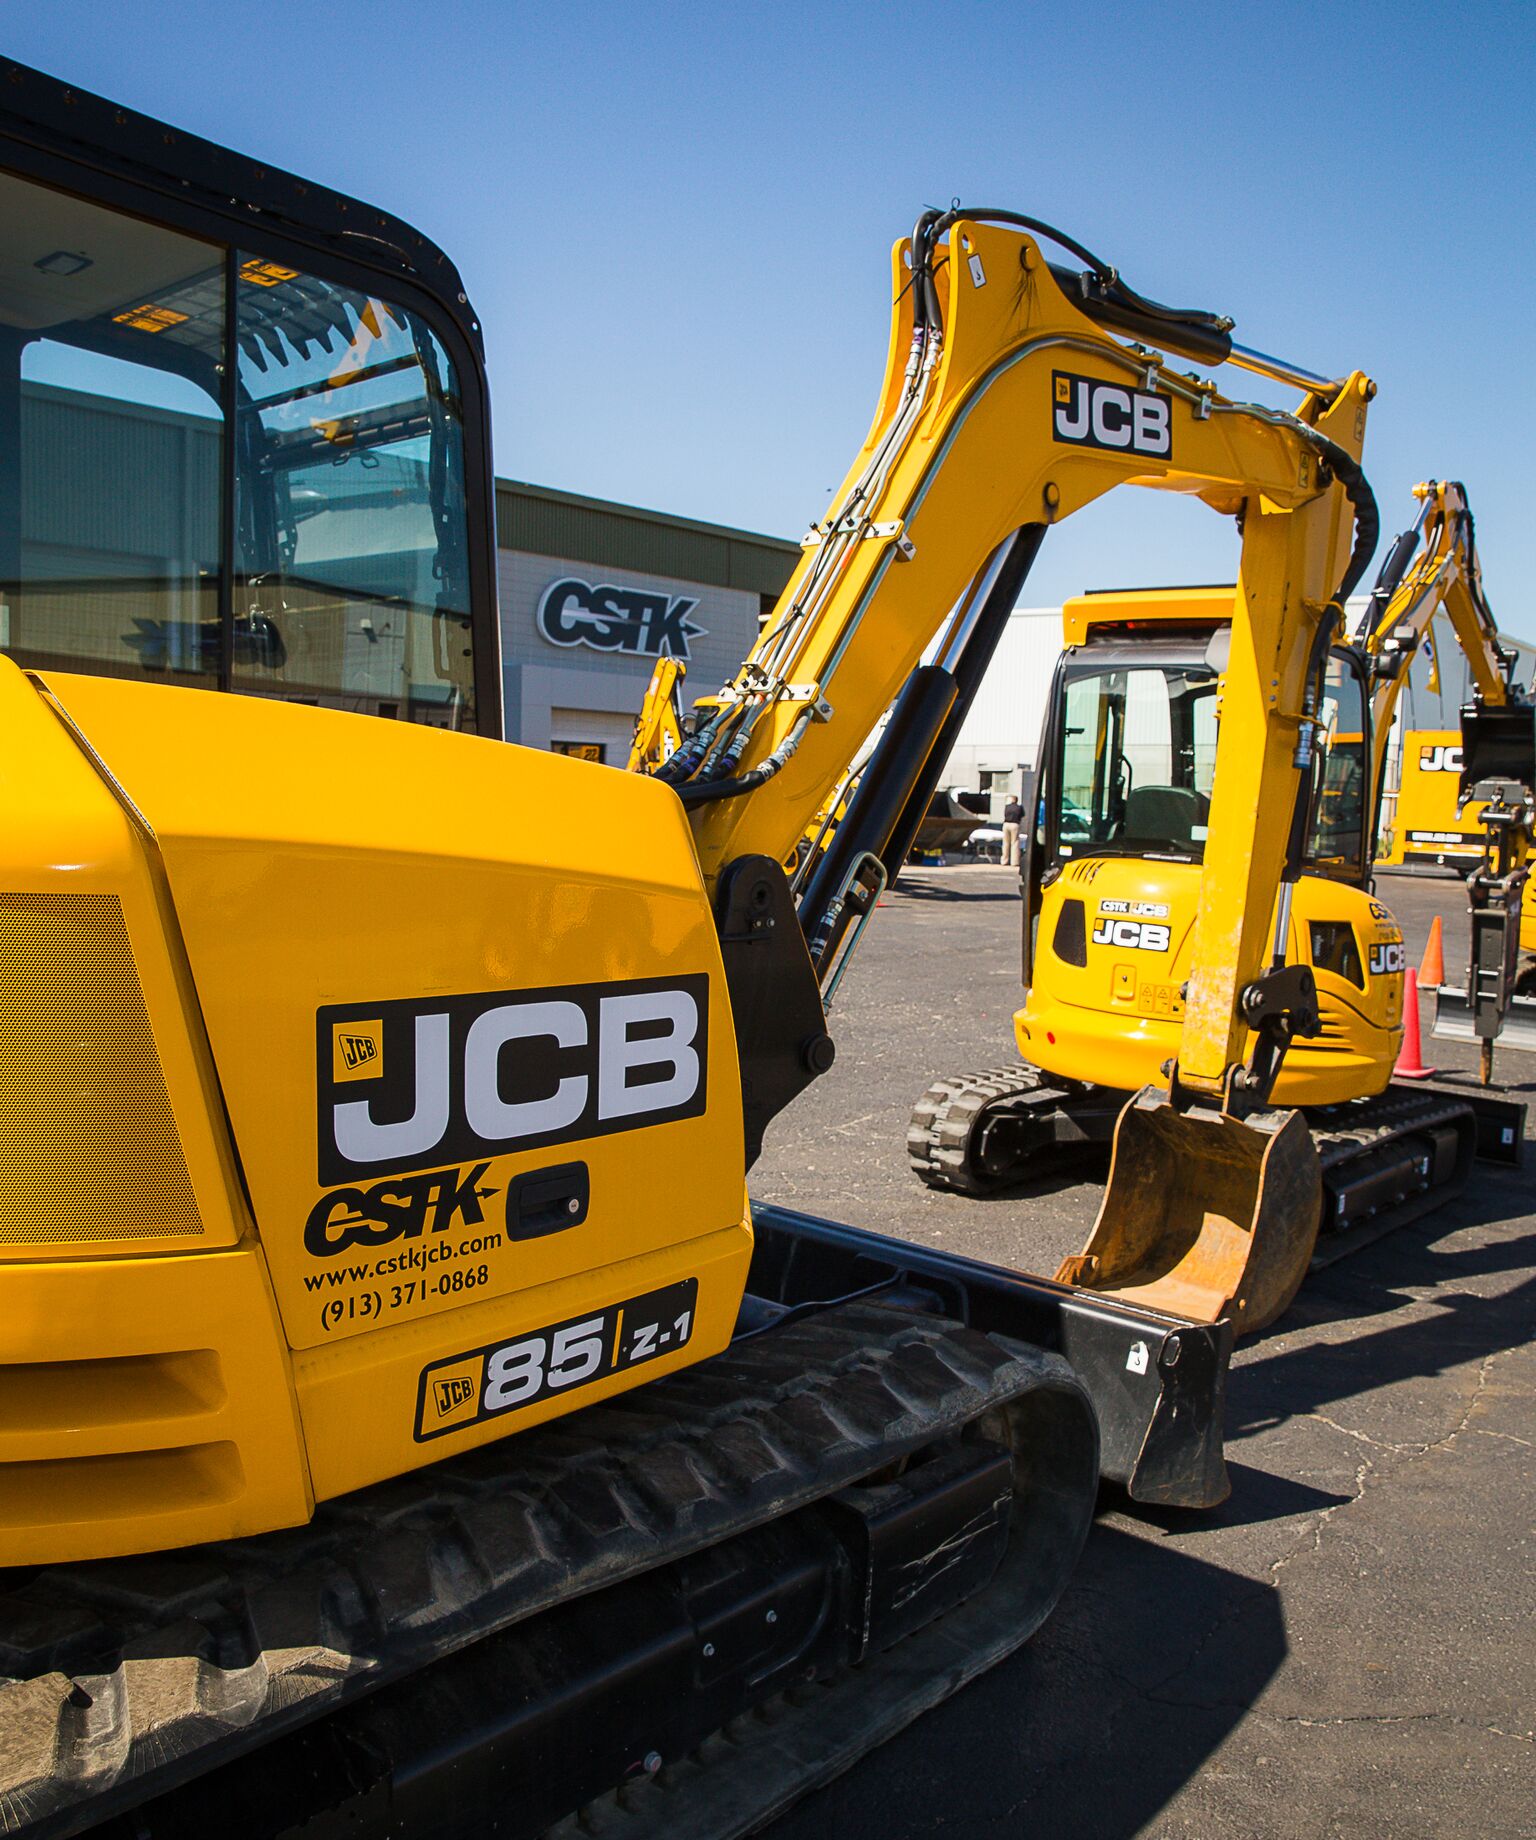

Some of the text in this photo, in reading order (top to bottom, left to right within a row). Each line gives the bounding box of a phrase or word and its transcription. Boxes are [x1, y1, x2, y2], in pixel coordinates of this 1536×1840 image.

[1056, 381, 1170, 454] JCB
[542, 580, 702, 658] CSTK
[1420, 746, 1464, 772] JC
[1093, 920, 1170, 951] JCB
[1132, 903, 1168, 917] JCB
[333, 990, 700, 1163] JCB
[346, 1038, 375, 1065] JCB
[304, 1161, 500, 1257] CSTK
[303, 1233, 502, 1292] www.cstkjcb.com
[321, 1264, 489, 1332] (913) 371-0868
[439, 1311, 691, 1413] JCB 85 Z-1
